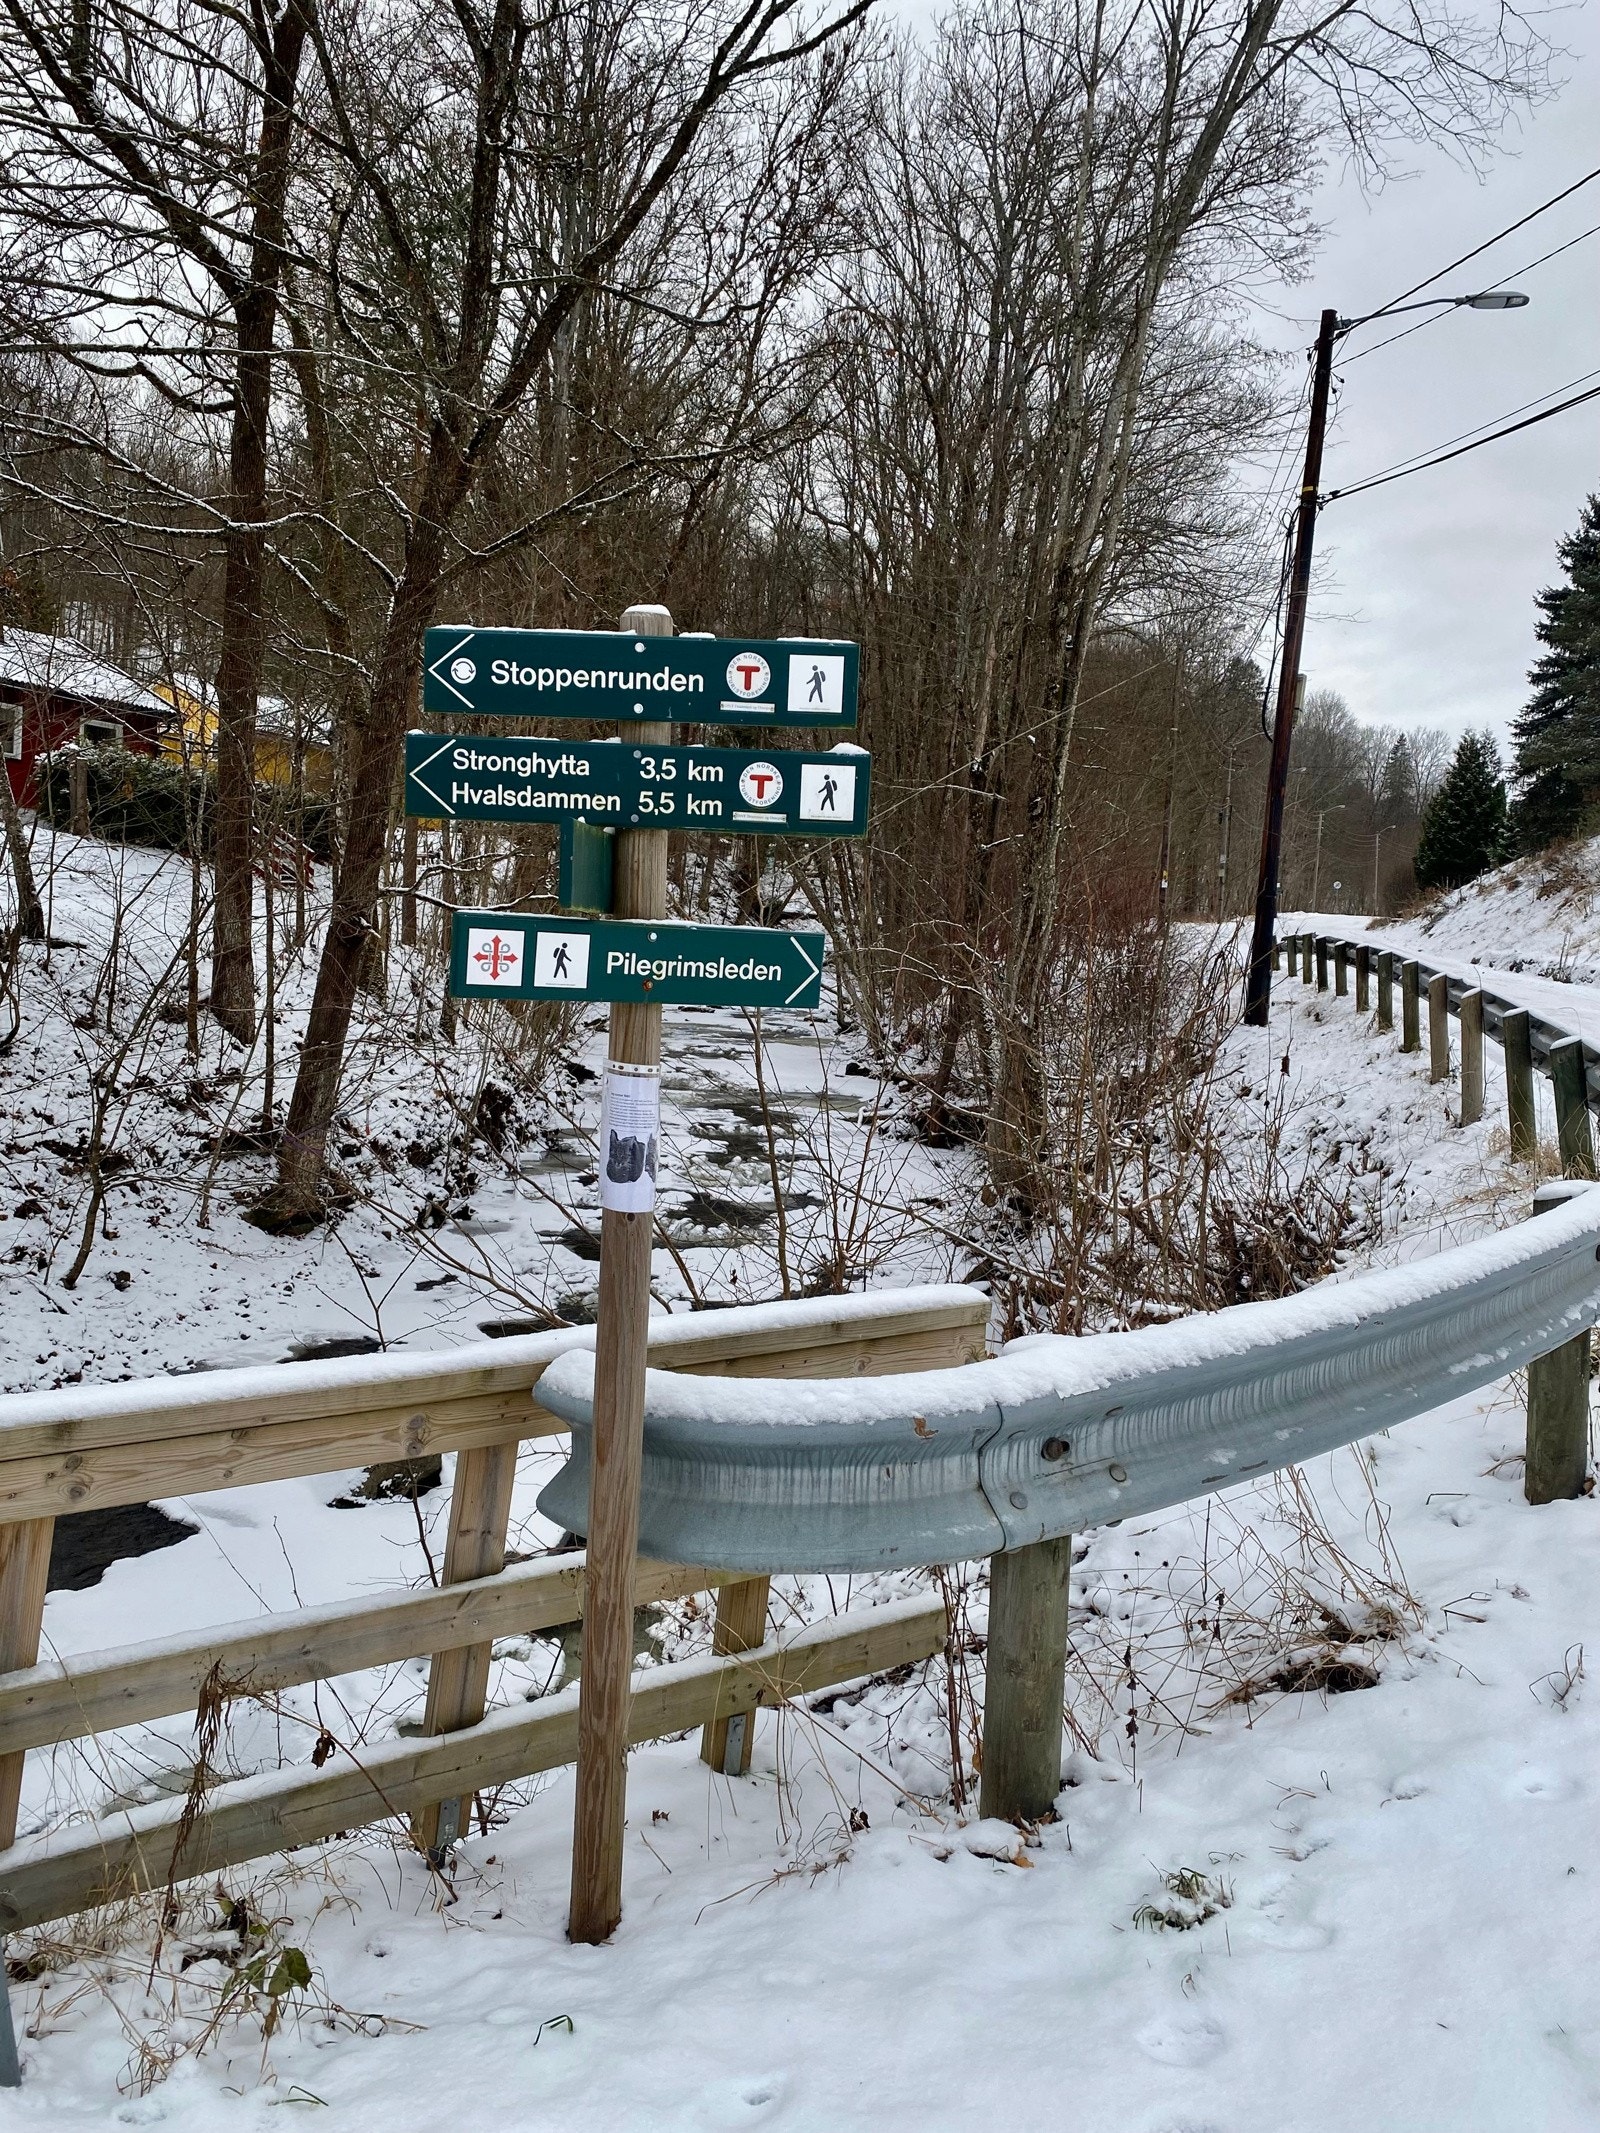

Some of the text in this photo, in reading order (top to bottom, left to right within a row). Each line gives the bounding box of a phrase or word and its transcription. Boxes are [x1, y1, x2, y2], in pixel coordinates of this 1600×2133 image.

[491, 659, 704, 692] Stoppenrunden
[736, 665, 761, 691] T
[452, 748, 724, 782] Stronghytta 3,5 km
[451, 782, 723, 816] Hvalsdammen 5,5 km
[749, 774, 774, 800] T
[606, 951, 782, 981] Pilegrimsleden
